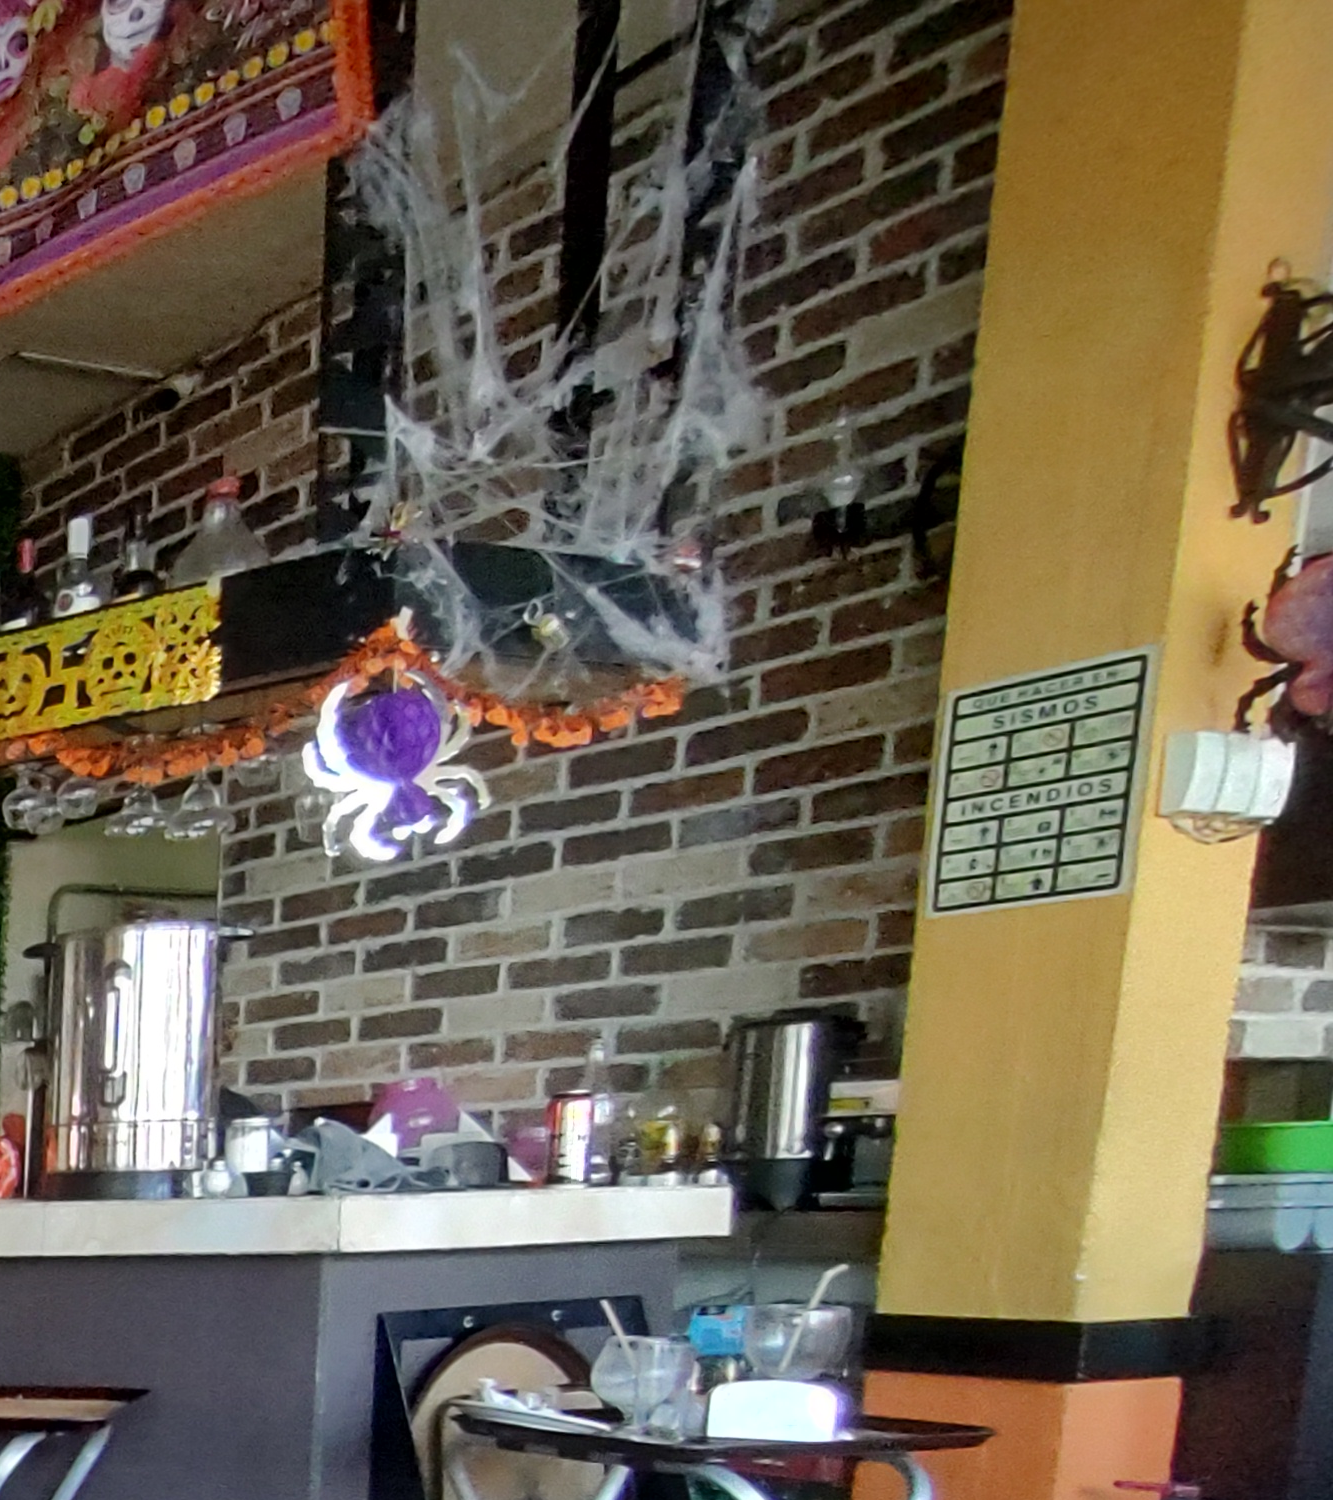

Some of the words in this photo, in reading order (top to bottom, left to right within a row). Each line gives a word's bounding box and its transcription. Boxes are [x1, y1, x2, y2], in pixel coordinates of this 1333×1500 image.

[1017, 676, 1083, 699] HACER
[991, 694, 1099, 730] SISMOS
[959, 778, 1113, 817] INCENDIOS
